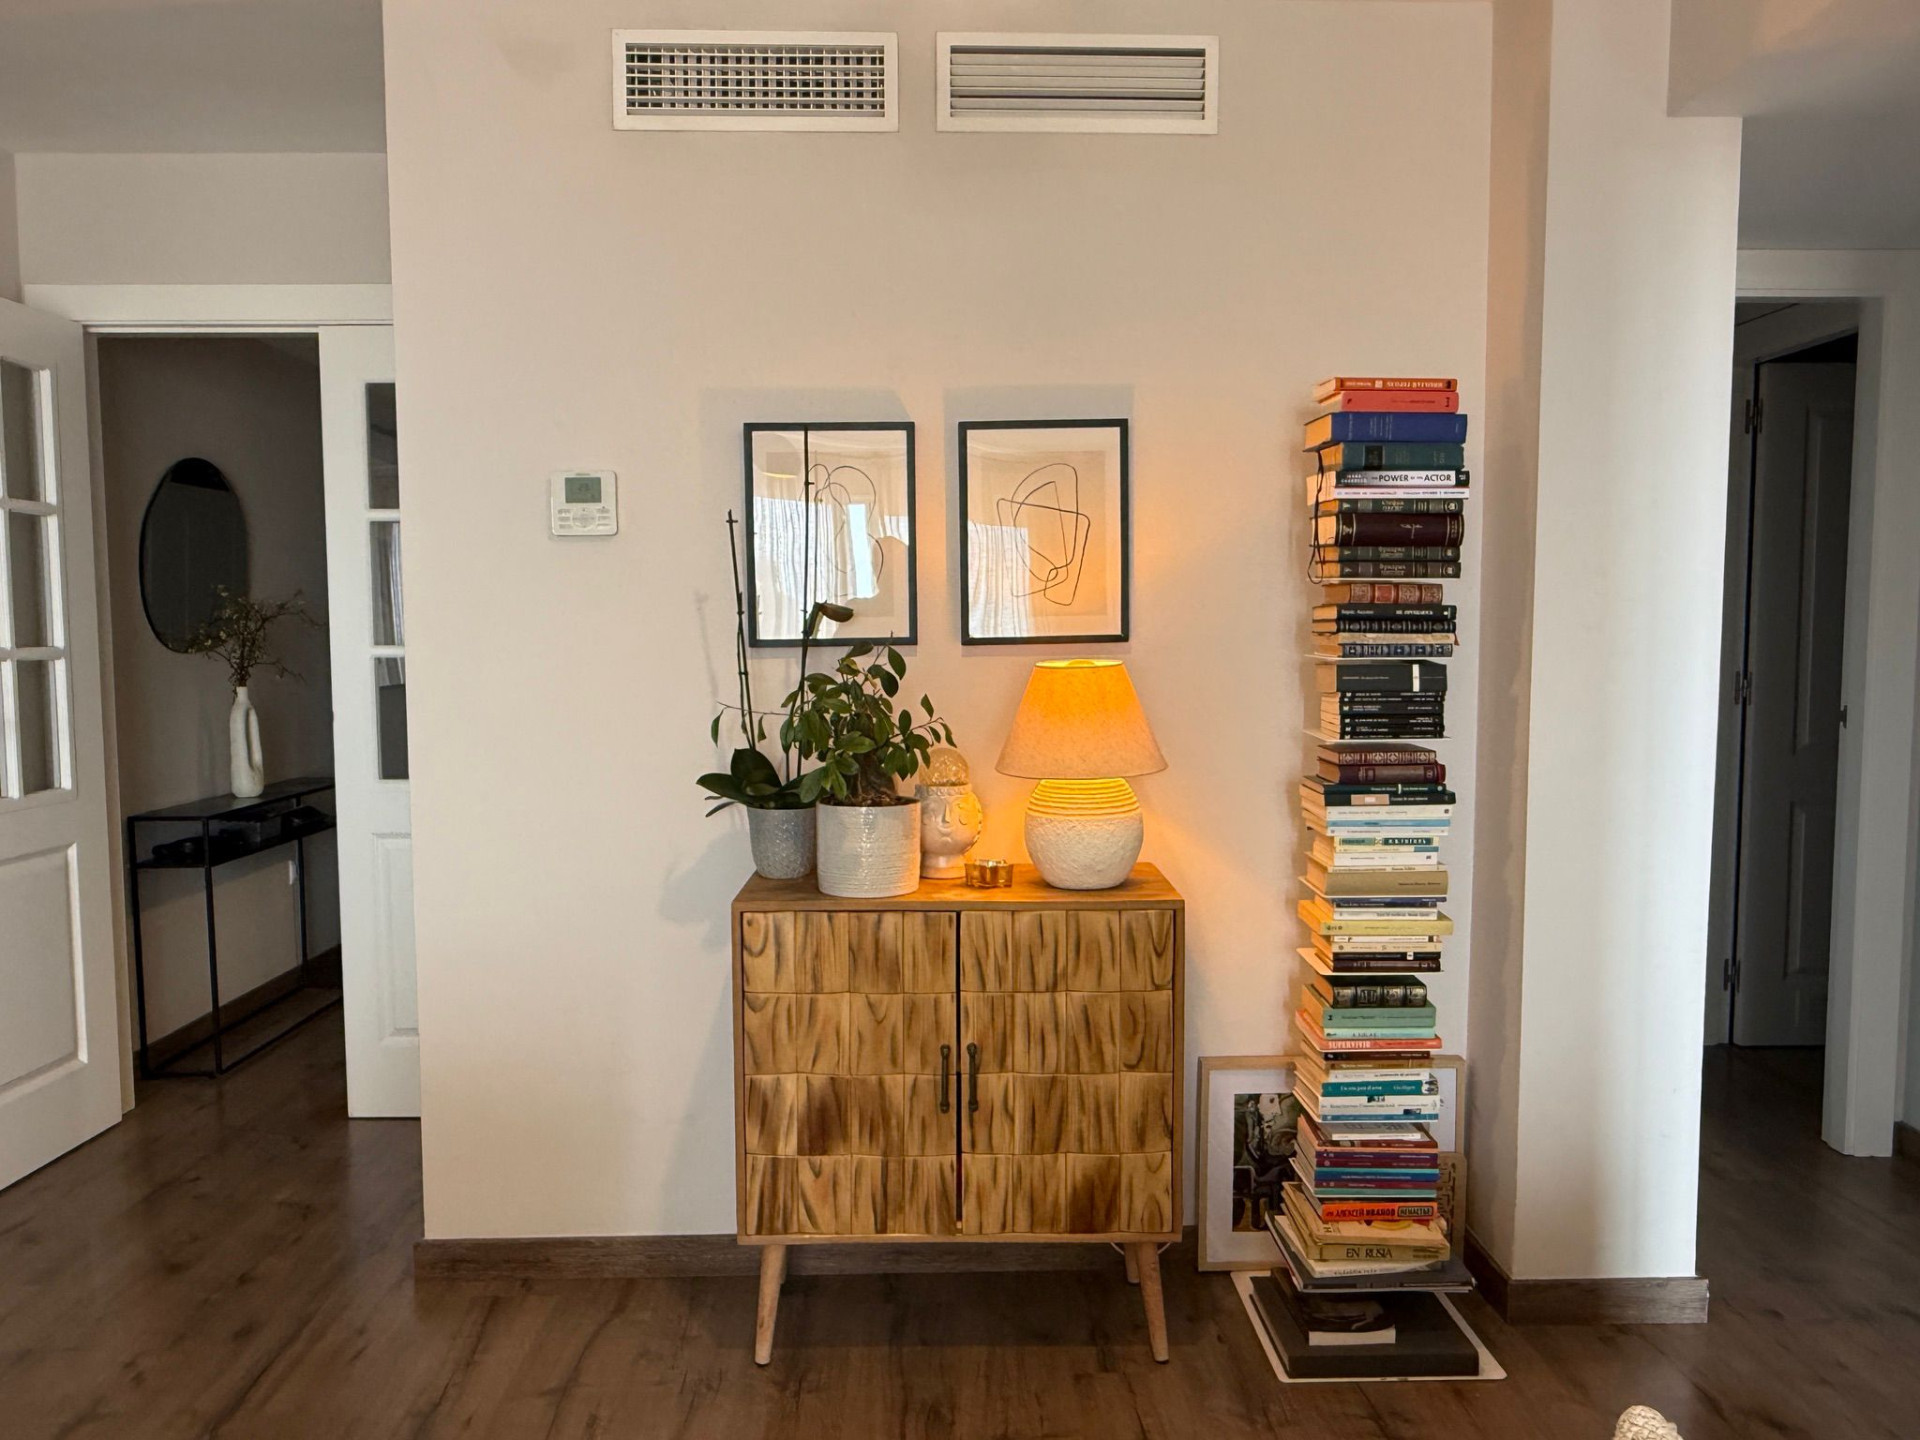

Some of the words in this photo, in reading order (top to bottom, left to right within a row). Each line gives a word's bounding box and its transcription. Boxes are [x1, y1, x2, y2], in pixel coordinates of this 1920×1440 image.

[1378, 473, 1409, 482] POWER
[1423, 473, 1452, 482] ACTOR
[1328, 1041, 1371, 1049] SUPERVIVIR
[1346, 1247, 1360, 1258] EN
[1365, 1248, 1393, 1259] RUSIA
